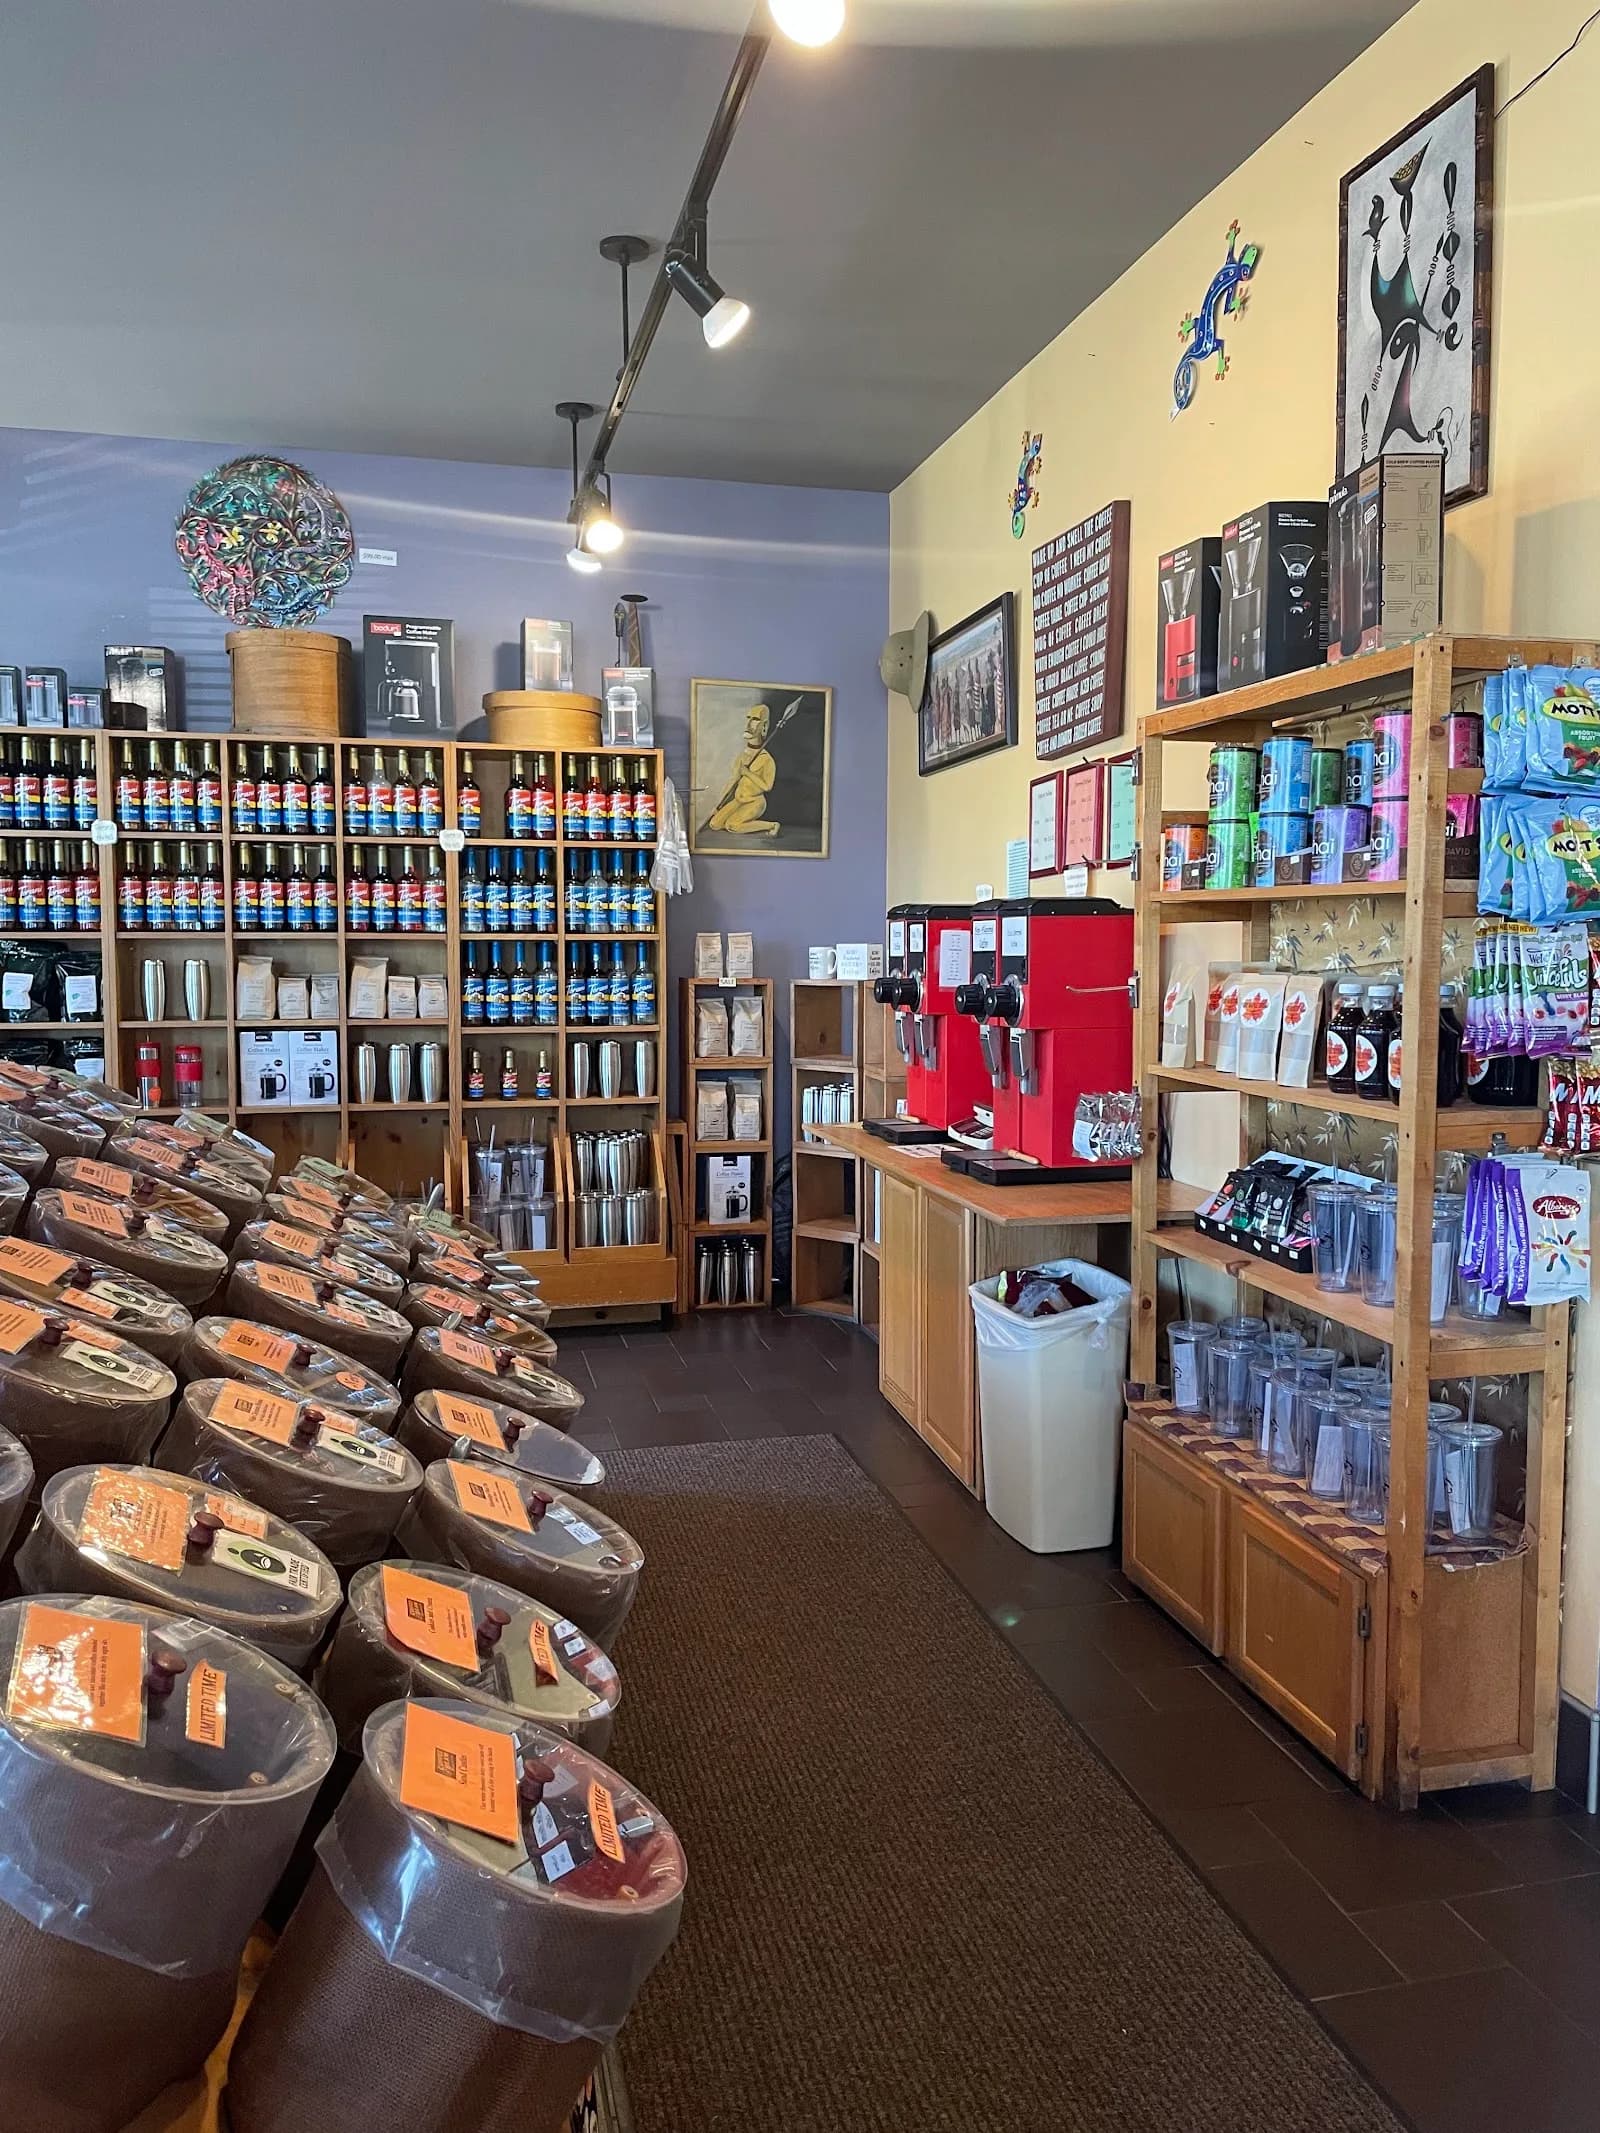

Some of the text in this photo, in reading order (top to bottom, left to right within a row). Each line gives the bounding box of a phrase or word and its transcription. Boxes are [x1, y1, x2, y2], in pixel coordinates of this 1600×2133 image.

[1084, 517, 1094, 538] THE
[1095, 506, 1112, 531] COFFEE
[1051, 556, 1067, 580] COFFEE
[1074, 609, 1091, 633] COFFEE
[18, 886, 42, 898] Torani
[48, 886, 70, 897] Torani
[119, 887, 141, 897] Torani
[146, 887, 169, 897] Torani
[174, 887, 195, 898] Torani
[201, 887, 222, 898] Torani
[1513, 1186, 1522, 1212] WORMS
[1518, 1255, 1526, 1282] FLAVOR
[289, 1558, 299, 1586] FAIR TRADE
[200, 1669, 216, 1741] LIMITED TIME
[591, 1784, 616, 1856] LIMITED TIME
